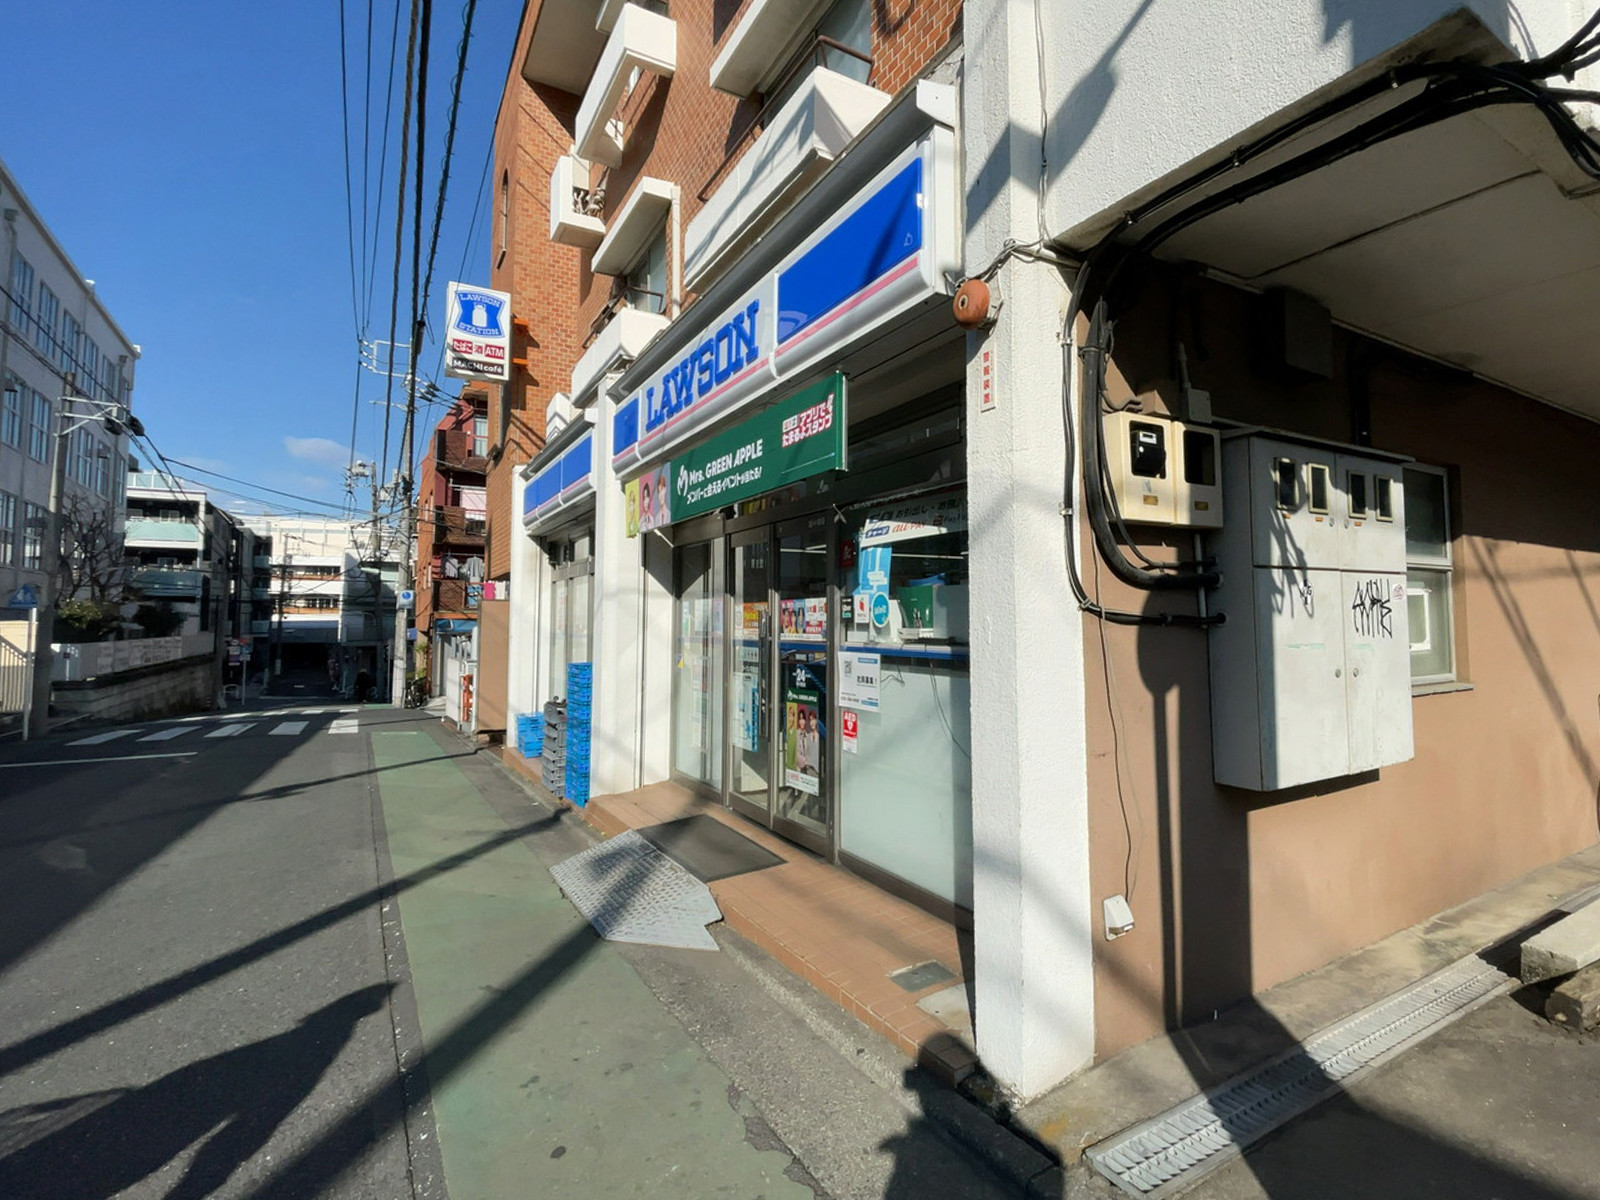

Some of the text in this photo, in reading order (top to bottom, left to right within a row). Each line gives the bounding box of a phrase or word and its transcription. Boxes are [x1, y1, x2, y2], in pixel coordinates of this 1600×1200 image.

[460, 293, 501, 307] LAWSON
[459, 321, 500, 335] STATION
[486, 346, 504, 358] ATM
[453, 359, 483, 371] MACHI
[644, 298, 760, 434] LAWSON
[689, 438, 763, 486] Mrs. GREEN APPLE
